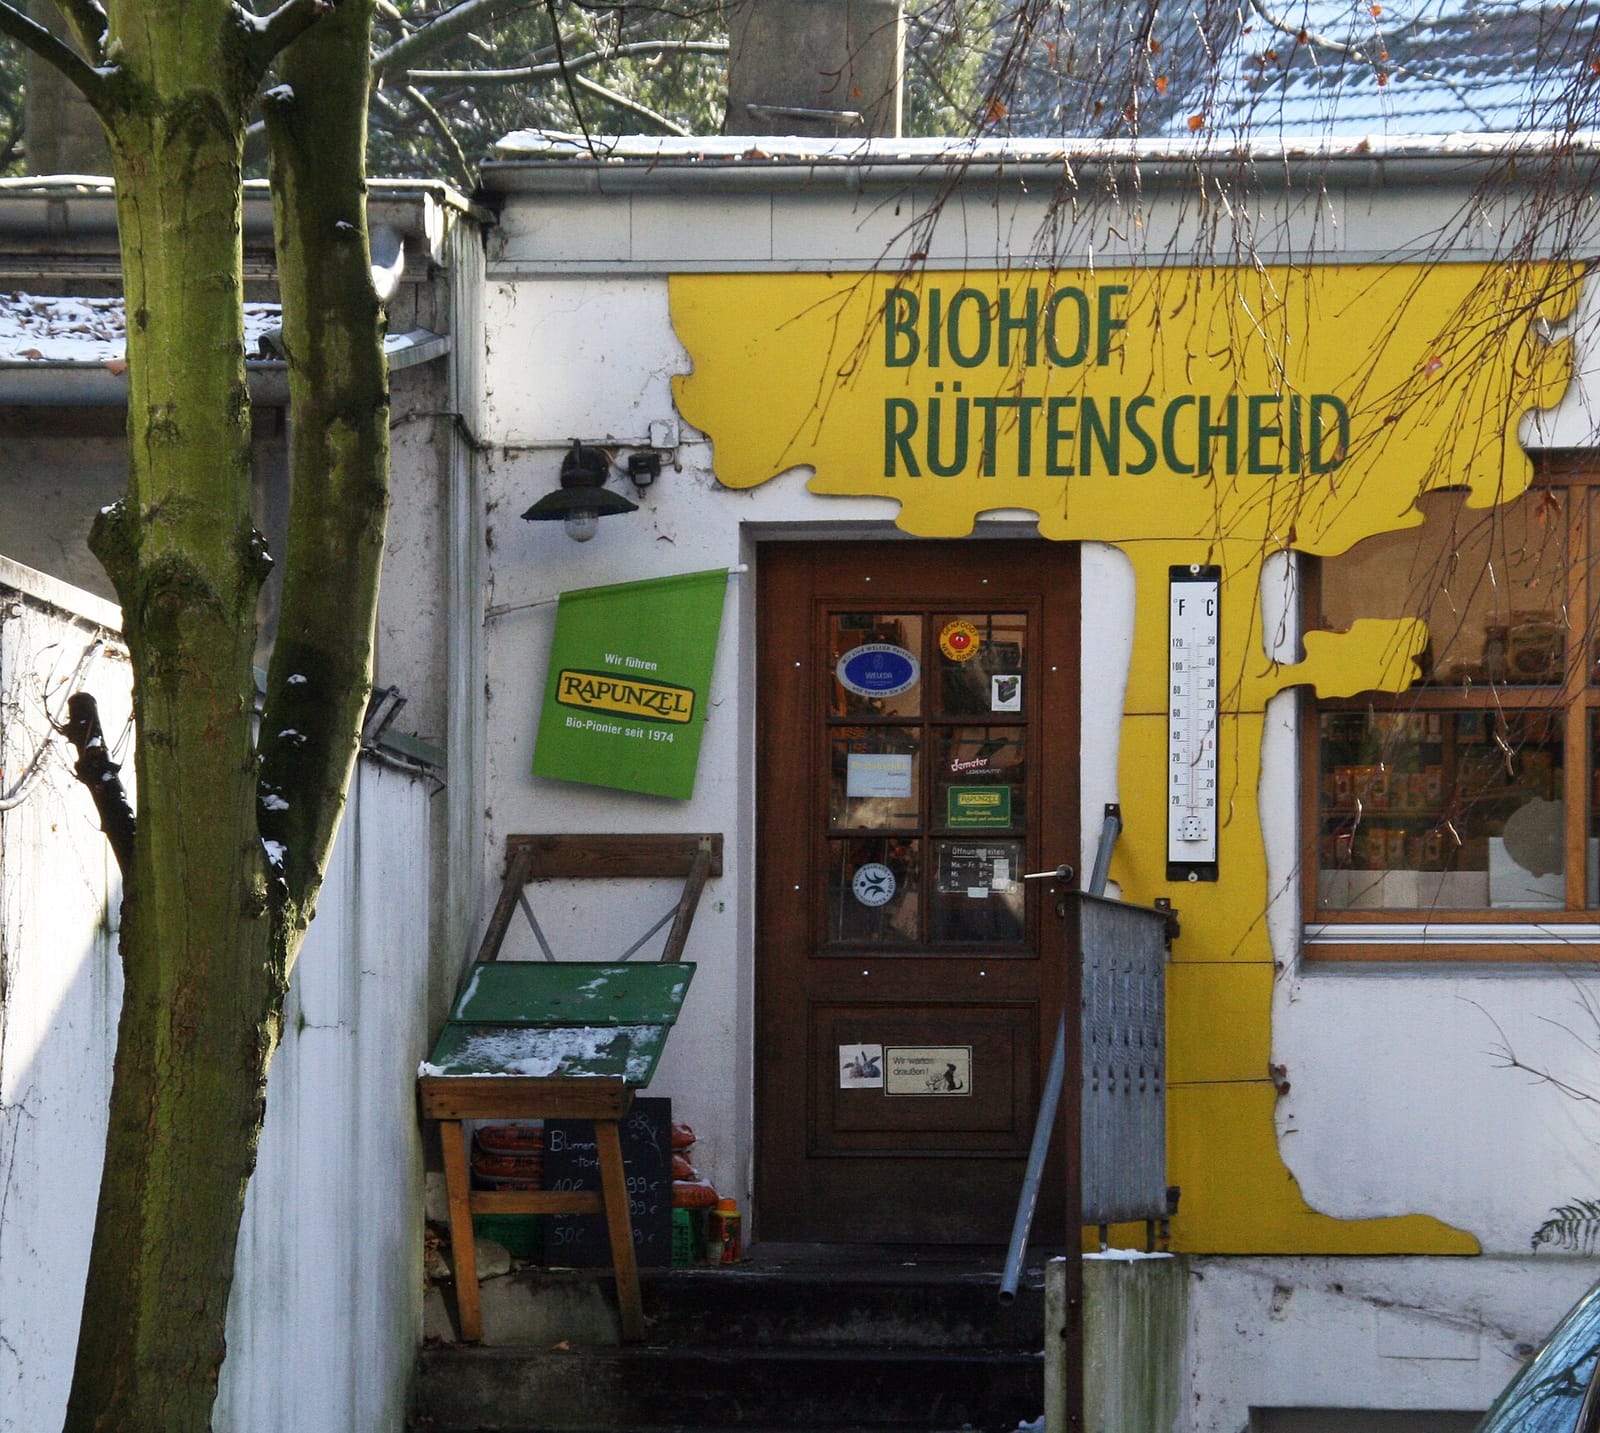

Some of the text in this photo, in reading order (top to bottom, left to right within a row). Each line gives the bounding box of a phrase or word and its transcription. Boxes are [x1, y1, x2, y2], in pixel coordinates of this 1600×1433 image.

[885, 285, 1128, 367] BIOHOF
[884, 381, 1349, 477] RÜTTENSCHEID
[605, 653, 657, 671] Wir führen
[564, 677, 688, 715] RAPUNZEL
[566, 717, 674, 743] Bio-Pionier seit 1974
[951, 758, 988, 772] demeter
